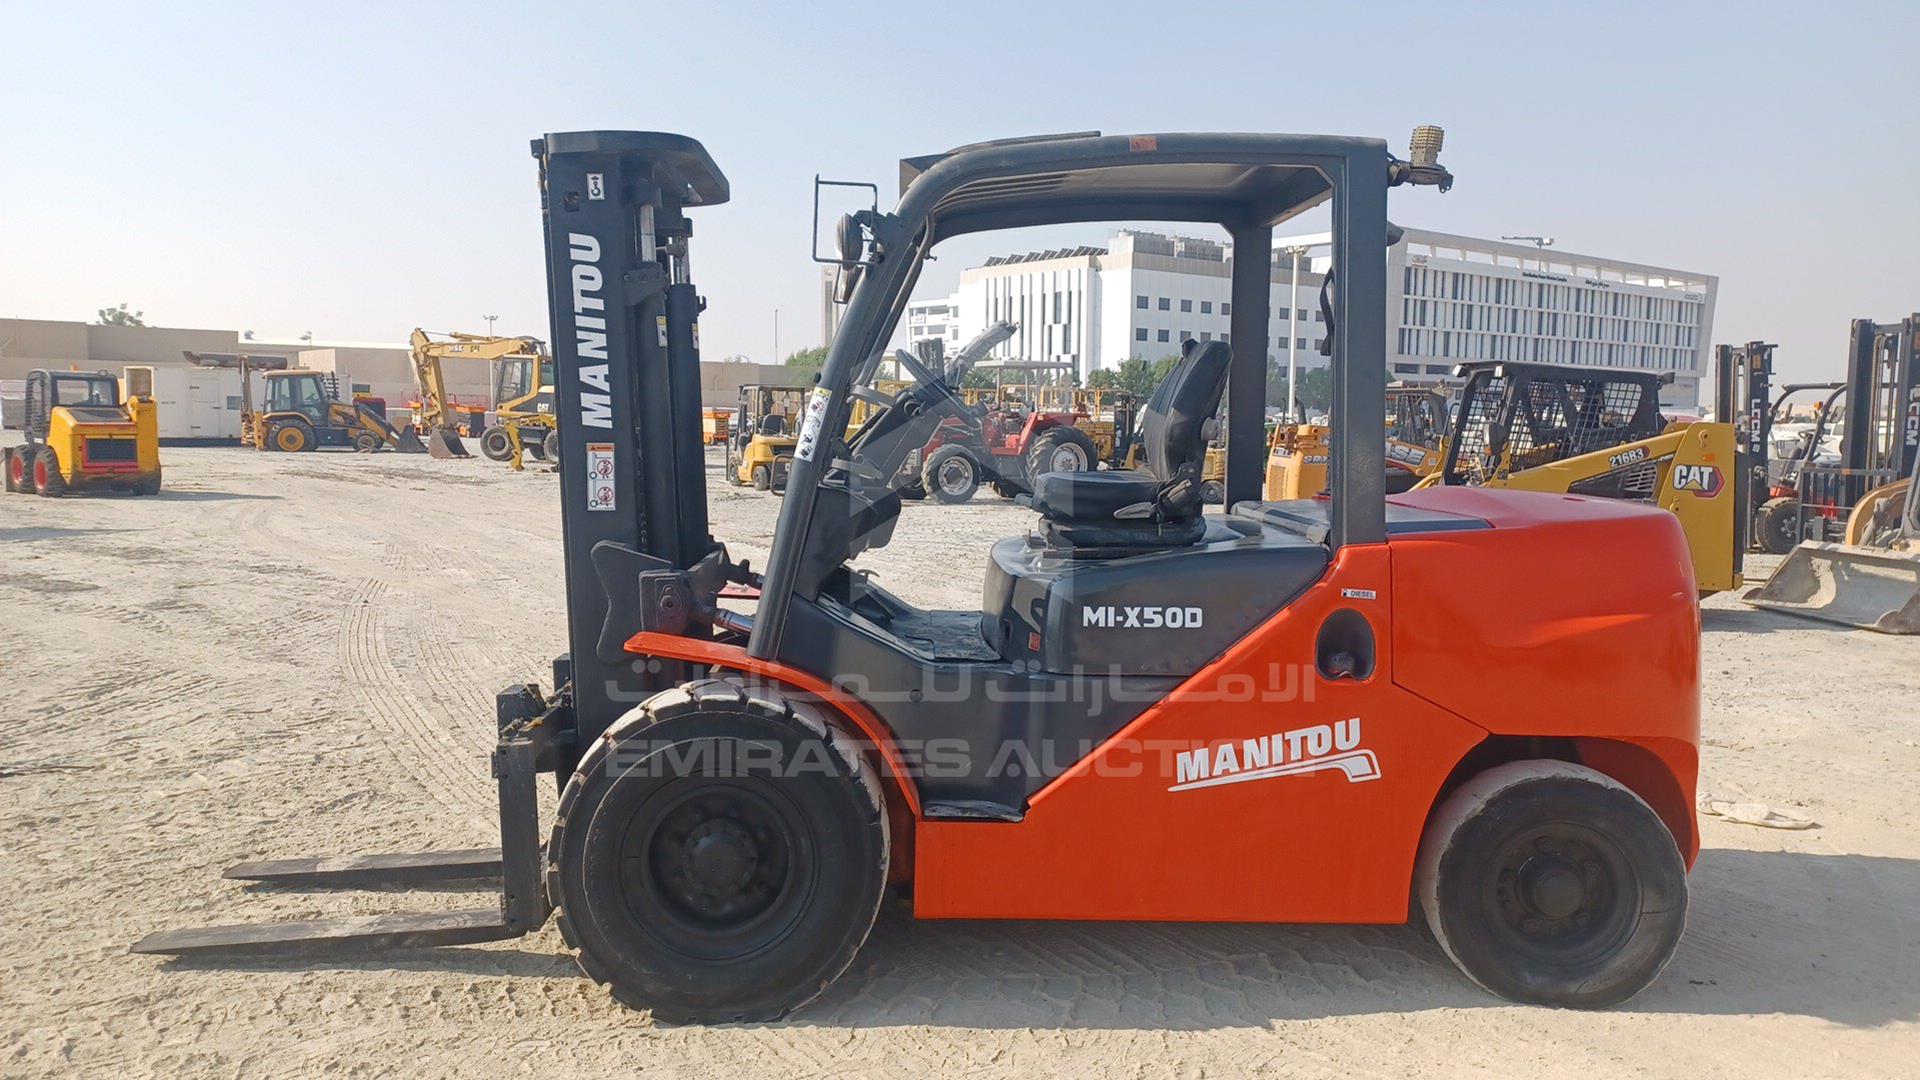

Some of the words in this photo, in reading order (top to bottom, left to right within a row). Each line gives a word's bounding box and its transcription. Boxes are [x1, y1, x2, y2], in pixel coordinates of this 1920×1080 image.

[569, 232, 613, 429] MANITOU
[537, 403, 550, 412] CAT
[1609, 447, 1645, 467] 216B3
[1674, 465, 1713, 490] CAT
[1082, 606, 1203, 628] MI-X50D
[1176, 717, 1361, 783] MANITOU
